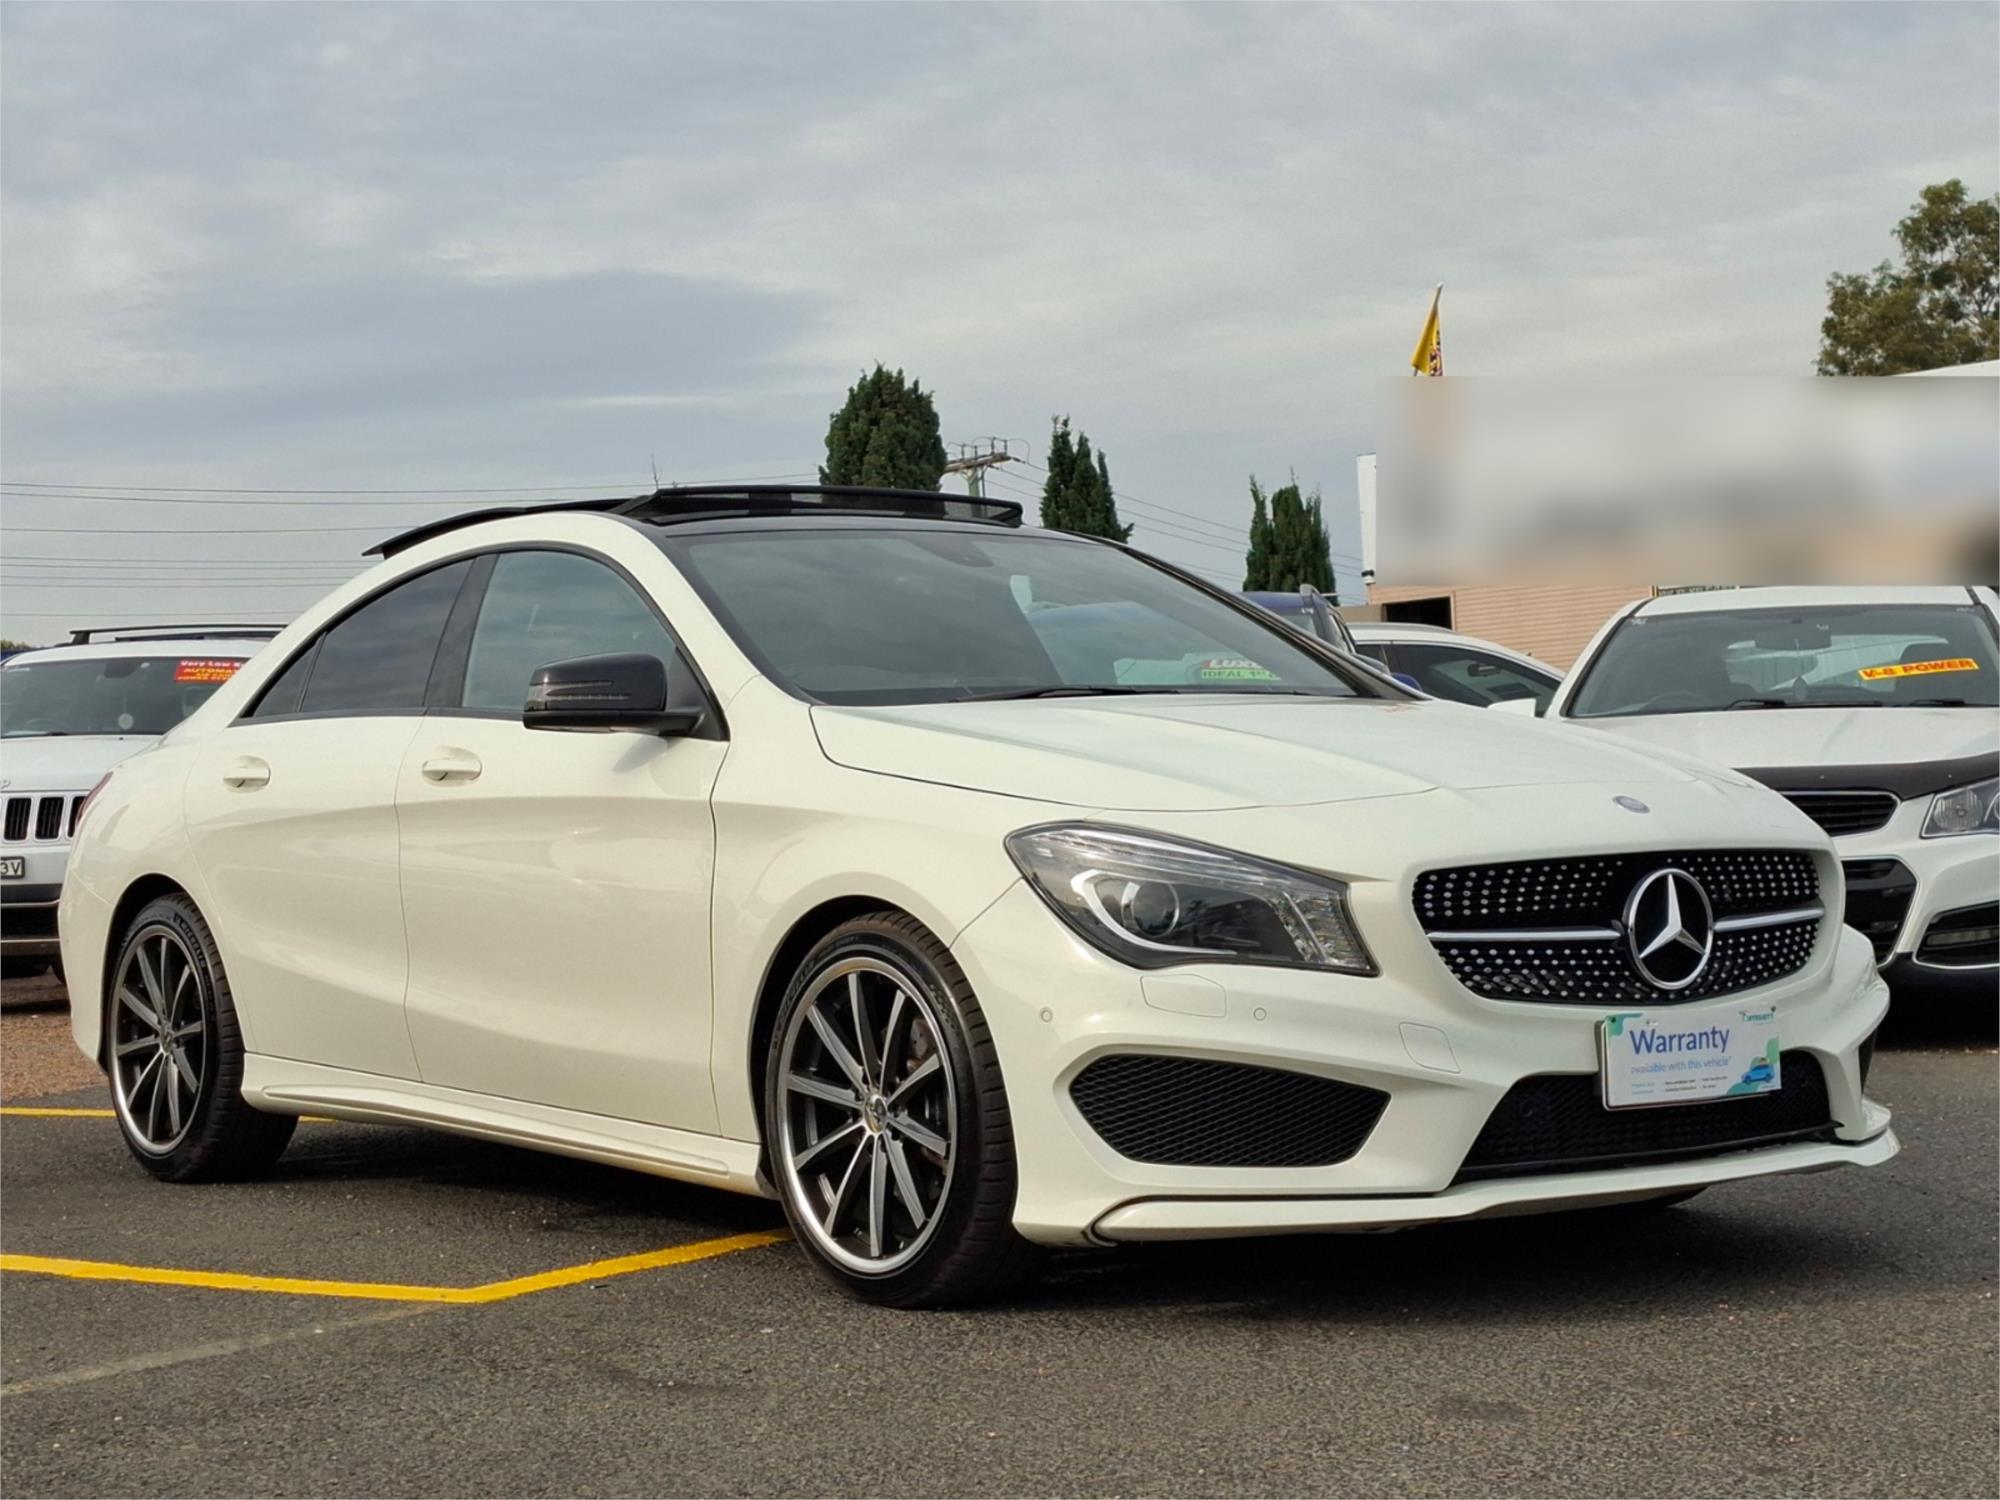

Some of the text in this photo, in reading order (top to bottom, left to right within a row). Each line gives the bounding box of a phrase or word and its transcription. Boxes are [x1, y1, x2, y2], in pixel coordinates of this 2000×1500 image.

[1903, 660, 1972, 673] POWER
[1629, 1025, 1730, 1055] Warranty
[1631, 1062, 1667, 1075] available
[1668, 1060, 1687, 1071] with
[1687, 1059, 1702, 1070] this
